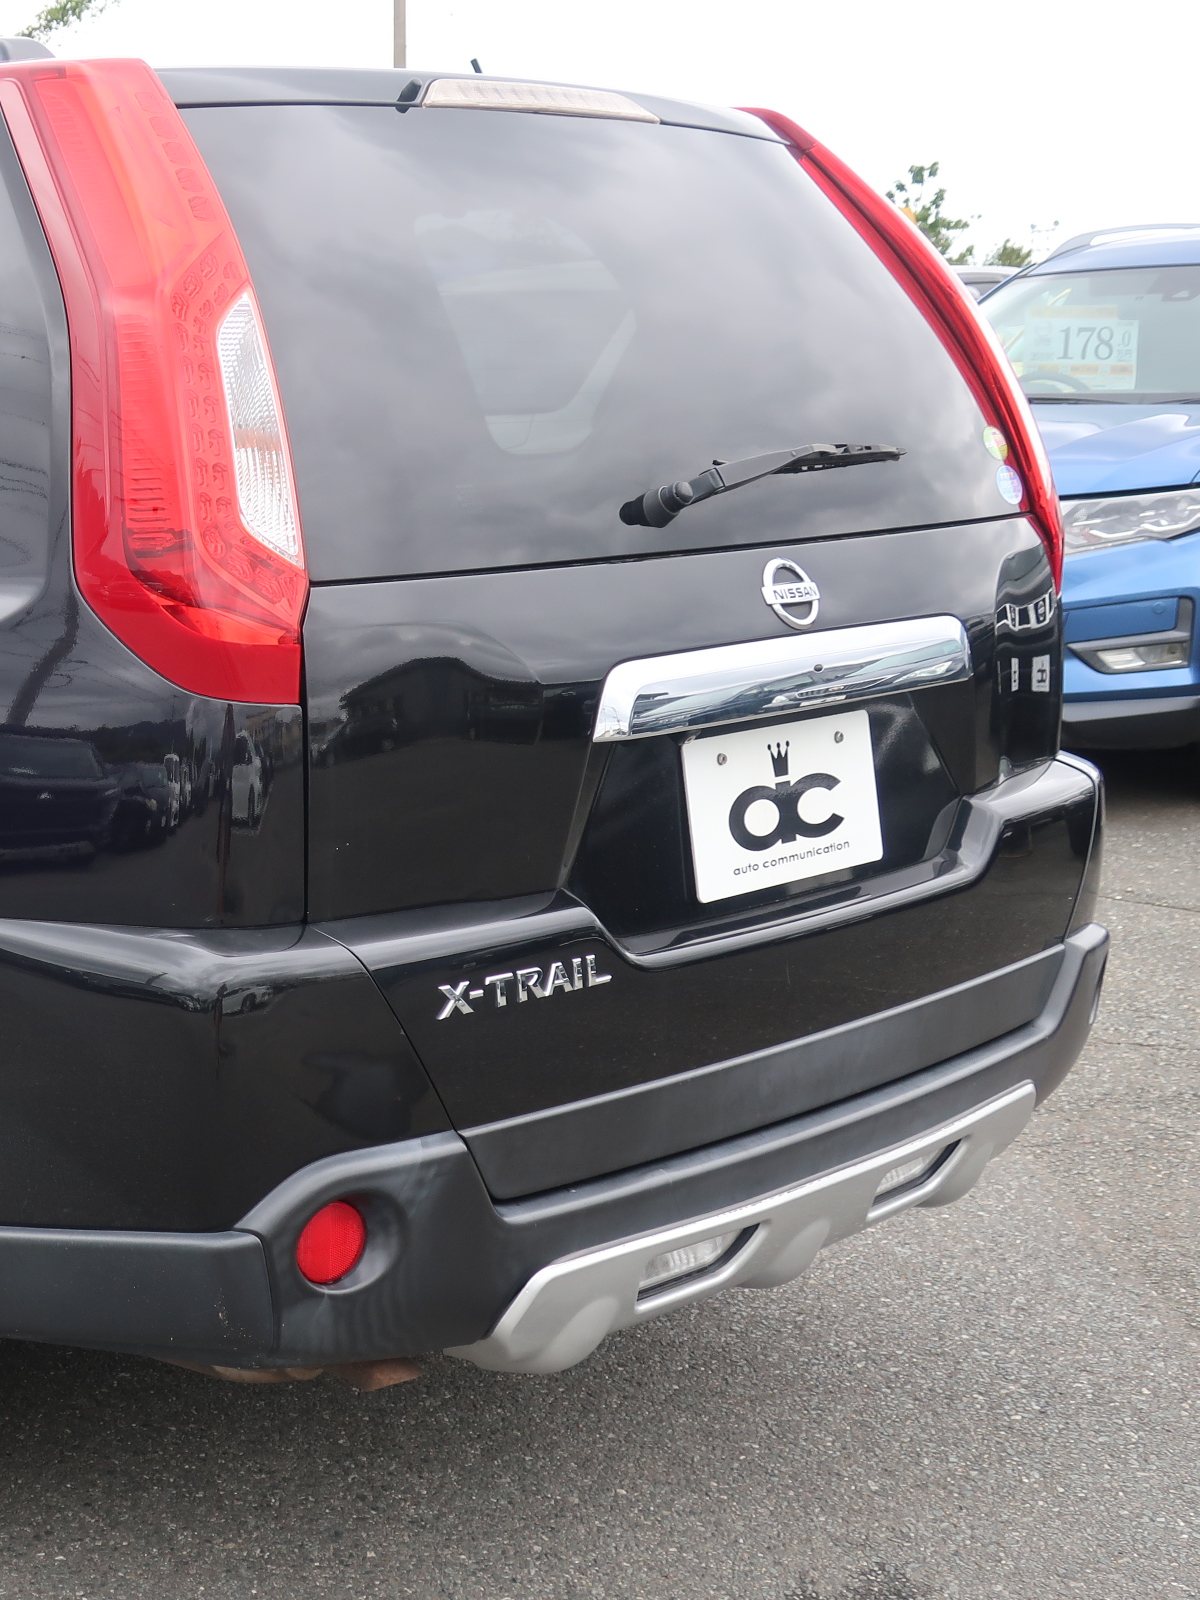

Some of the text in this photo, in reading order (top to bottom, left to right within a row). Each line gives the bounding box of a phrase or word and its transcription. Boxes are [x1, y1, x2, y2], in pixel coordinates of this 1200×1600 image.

[1057, 326, 1114, 360] 178
[773, 586, 818, 600] NISSAN
[733, 840, 850, 876] auto communication
[436, 954, 613, 1021] X-TRAIL
